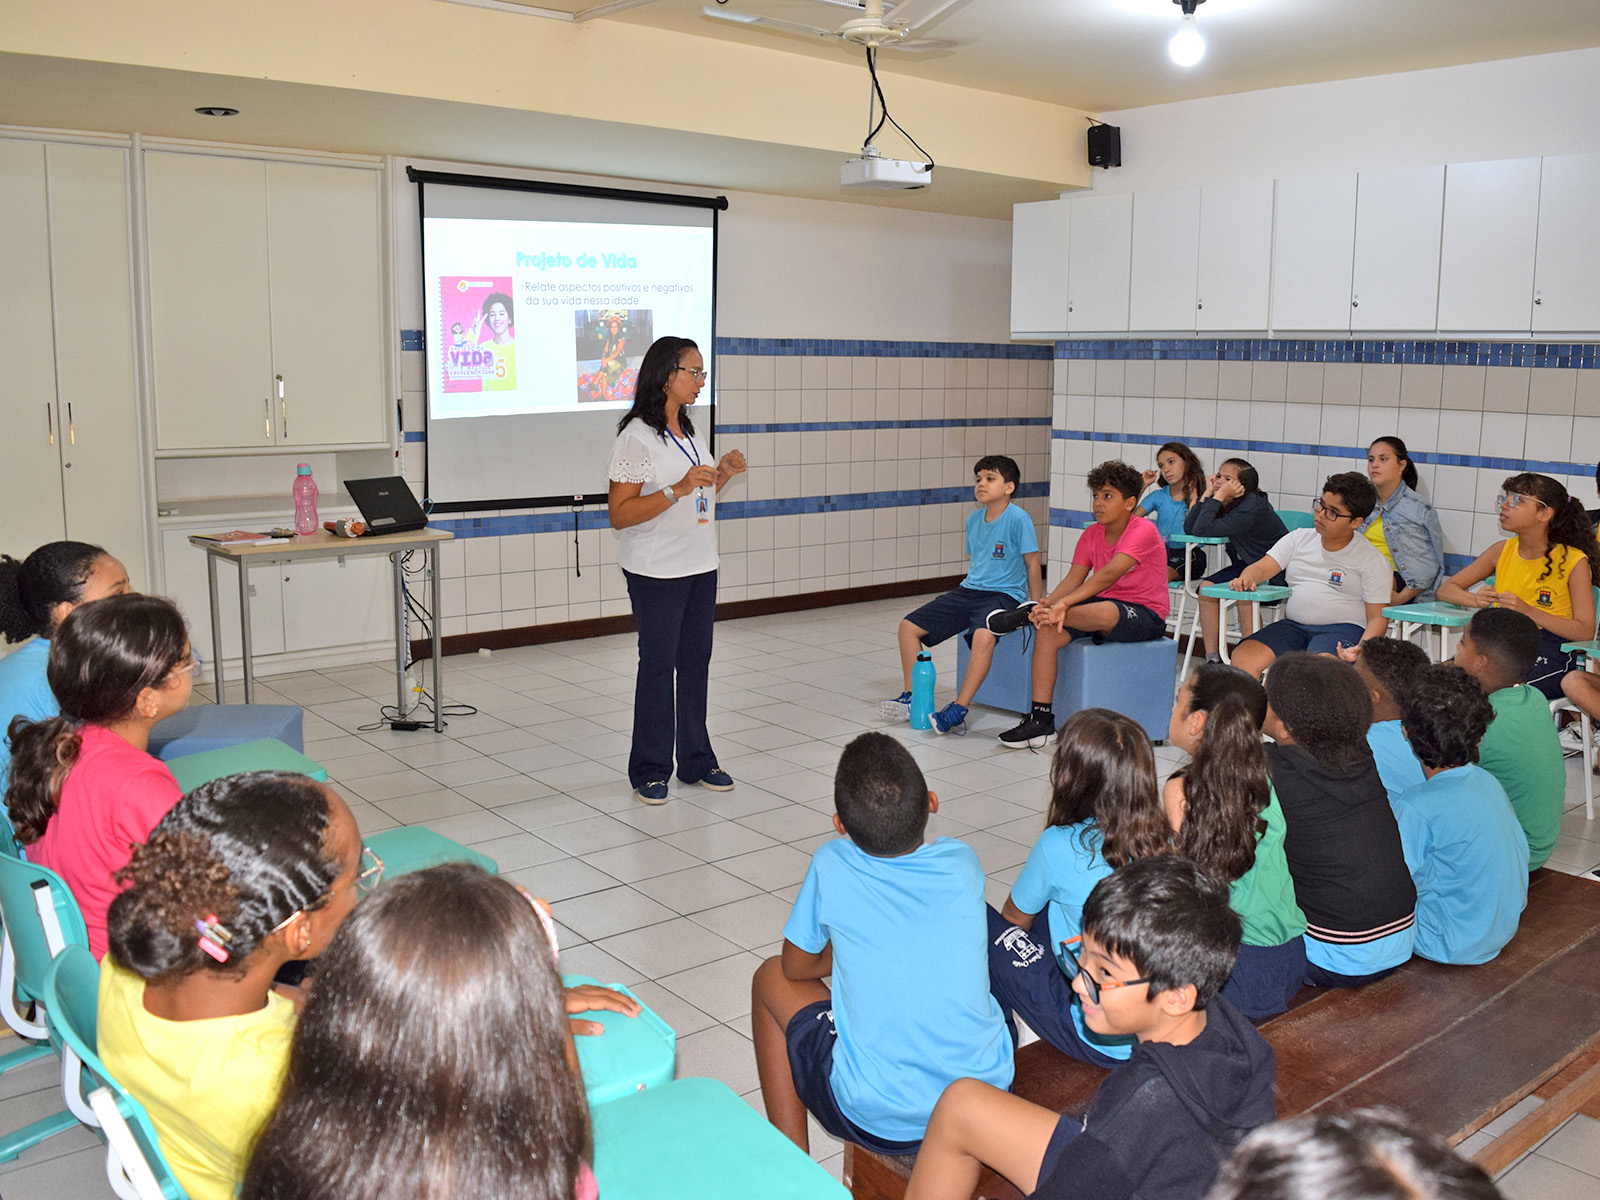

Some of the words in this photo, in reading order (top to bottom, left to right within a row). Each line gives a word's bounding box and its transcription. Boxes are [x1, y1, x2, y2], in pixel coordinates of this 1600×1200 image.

[516, 251, 572, 271] Projeto
[576, 252, 598, 268] de
[601, 253, 637, 269] Vida
[524, 282, 557, 292] Relate
[558, 283, 601, 293] aspectos
[603, 283, 641, 293] positivos
[643, 284, 649, 292] e
[651, 283, 694, 294] negativos
[525, 296, 540, 305] da
[542, 297, 559, 305] sua
[561, 296, 582, 305] vida
[583, 297, 610, 305] nessa
[611, 296, 639, 305] idade
[496, 358, 506, 378] 5
